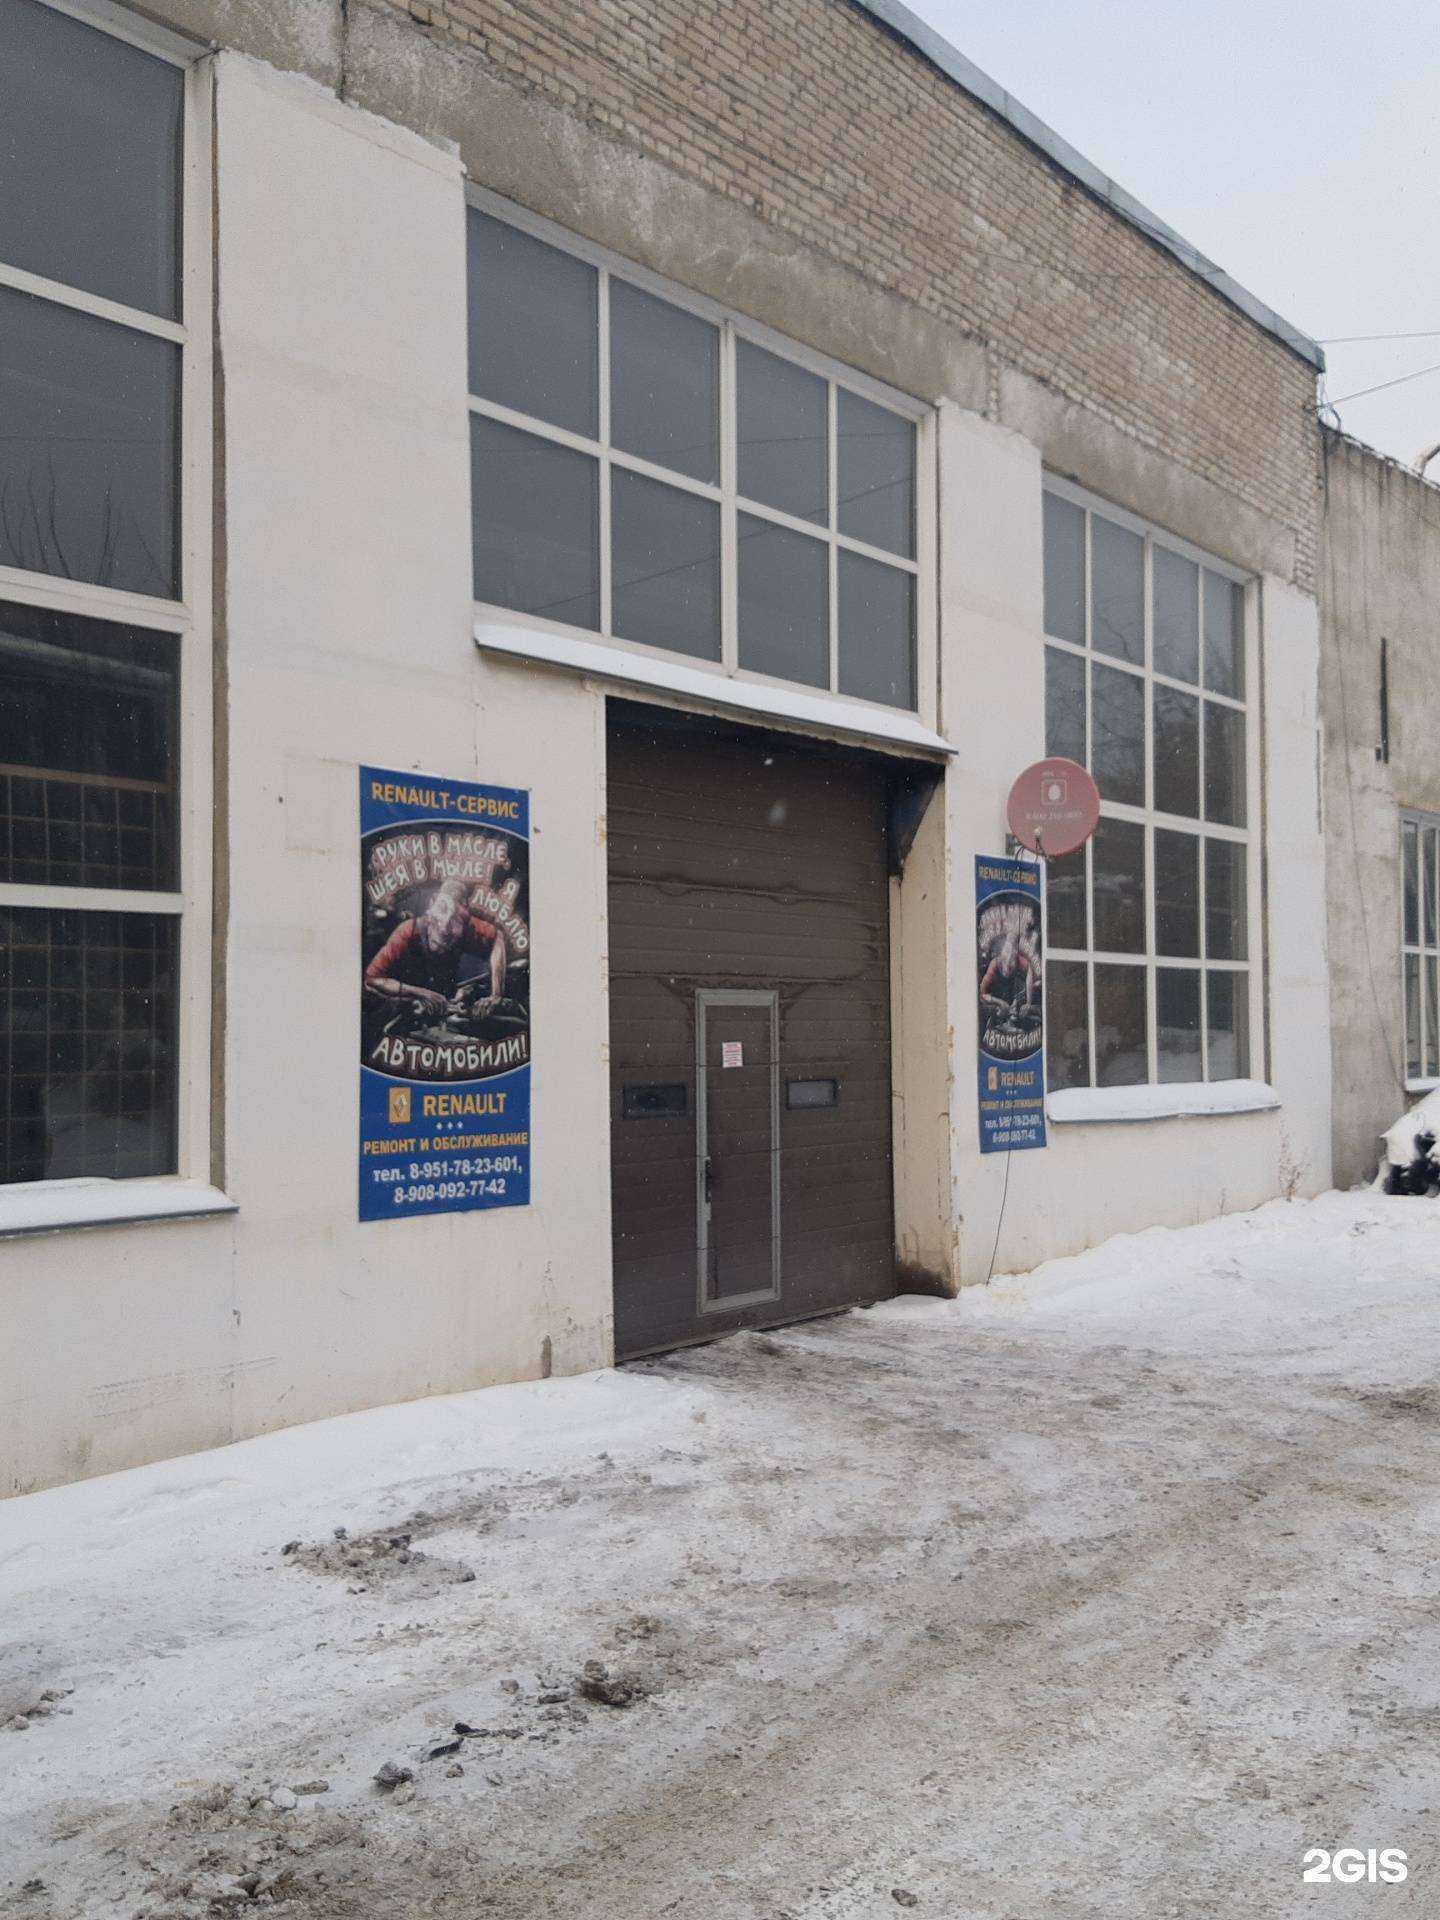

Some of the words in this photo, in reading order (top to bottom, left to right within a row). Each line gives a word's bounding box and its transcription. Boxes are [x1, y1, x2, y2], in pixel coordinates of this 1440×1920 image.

[371, 782, 520, 819] RENAULT-СЕРВИС
[375, 837, 425, 867] РУКИ
[428, 834, 442, 855] В
[368, 866, 411, 900] ШЕЯ
[413, 859, 427, 881] В
[433, 857, 492, 881] МЫЛЕ!
[502, 880, 518, 900] Я
[472, 888, 528, 948] ЛЮБЛЮ
[372, 1034, 527, 1072] АВТОМОБИЛИ!
[423, 1093, 507, 1117] RENAULT
[363, 1138, 416, 1155] РЕМОНТ
[420, 1138, 429, 1151] И
[433, 1132, 528, 1151] ОБСЛУЖИВАНИЕ
[373, 1168, 405, 1182] тел.
[409, 1156, 523, 1180] 8-951-78-23-601,
[394, 1178, 506, 1203] 8-908-092-77-42
